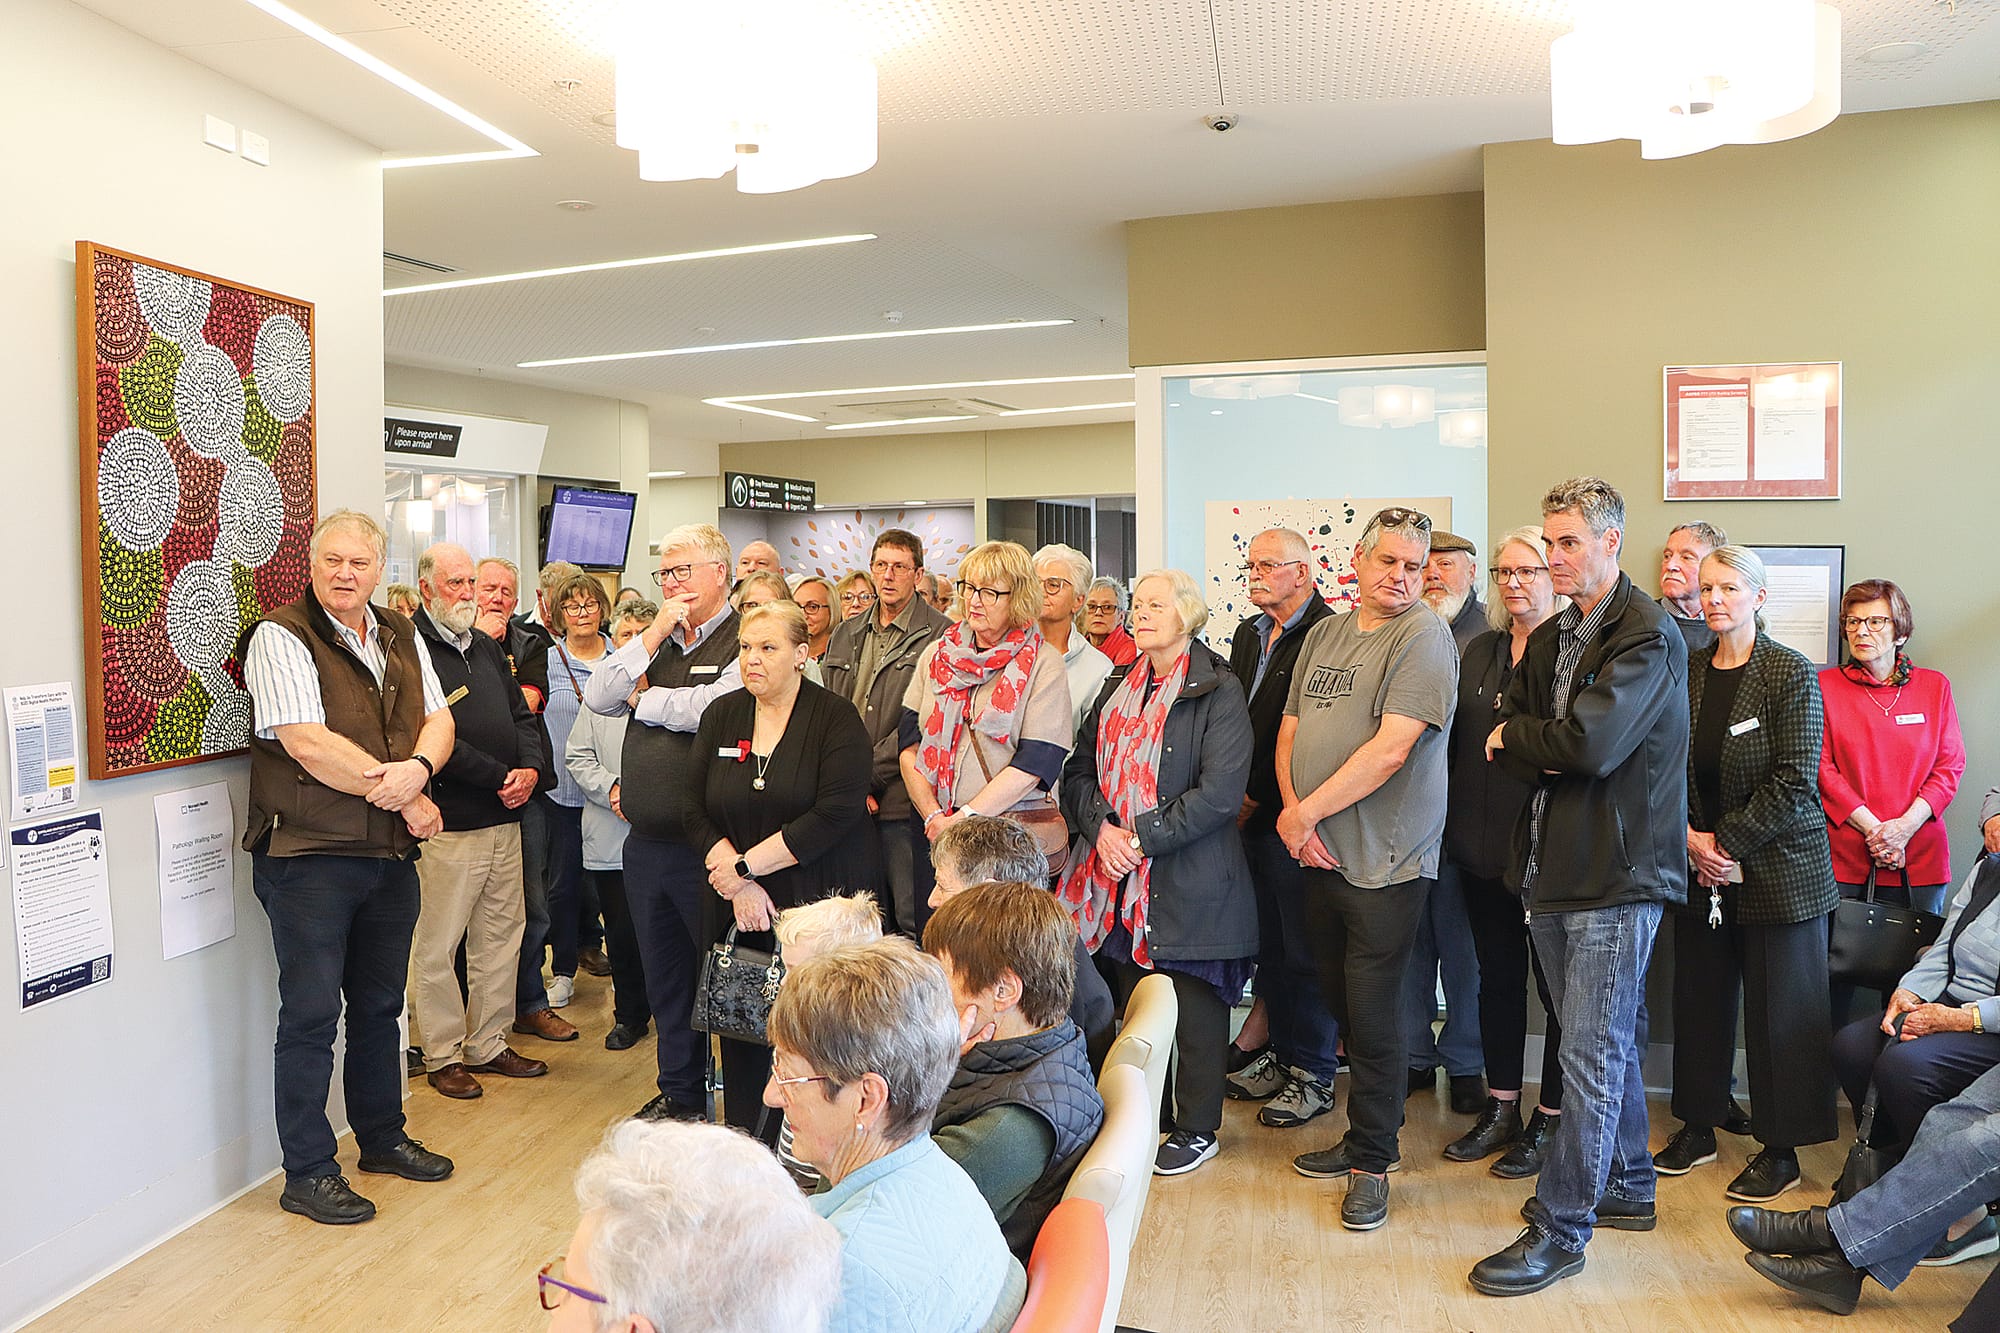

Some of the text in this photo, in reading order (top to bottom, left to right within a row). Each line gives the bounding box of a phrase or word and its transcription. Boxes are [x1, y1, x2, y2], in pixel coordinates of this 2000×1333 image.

[396, 426, 417, 437] Please
[418, 430, 438, 439] report
[438, 431, 454, 441] here
[394, 439, 433, 449] upon arrival
[172, 840, 194, 850] Pathology
